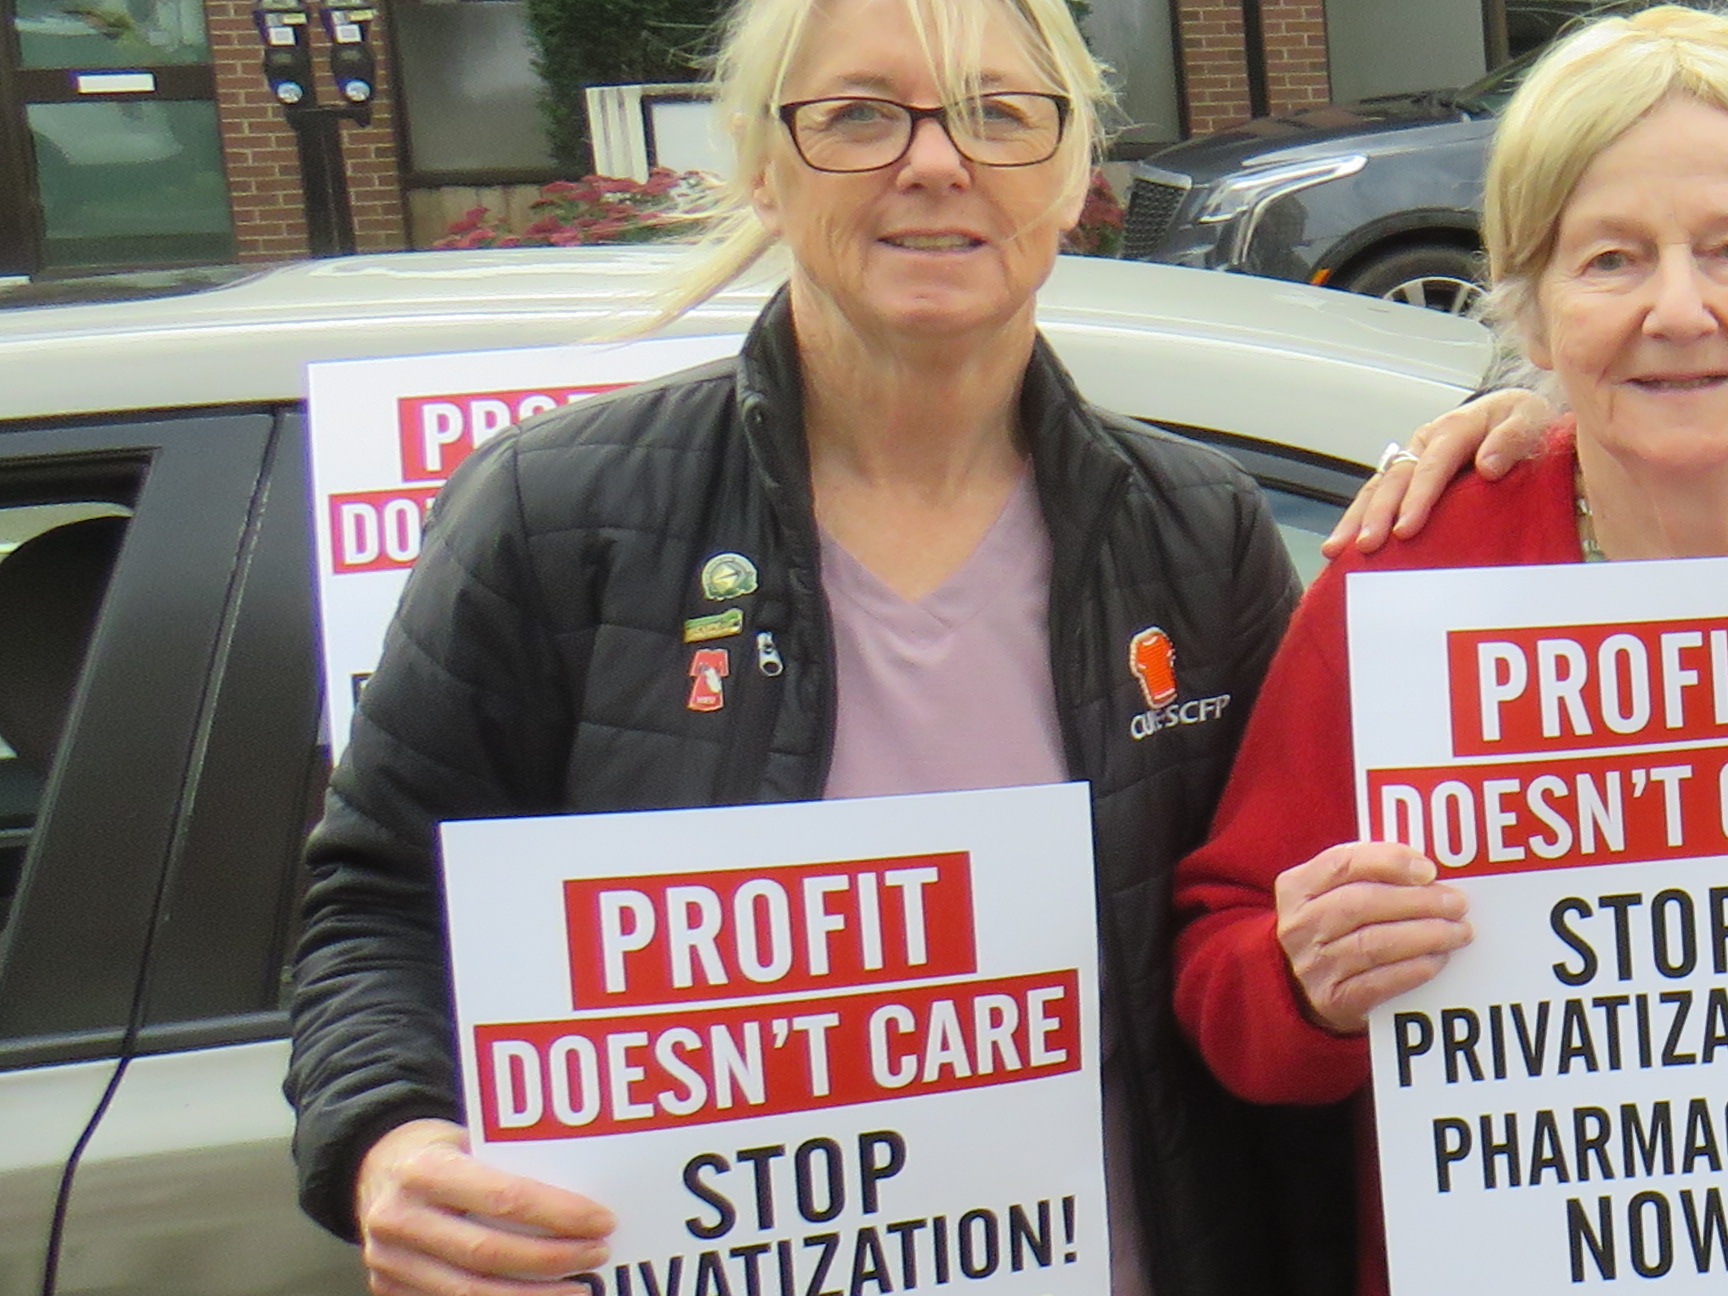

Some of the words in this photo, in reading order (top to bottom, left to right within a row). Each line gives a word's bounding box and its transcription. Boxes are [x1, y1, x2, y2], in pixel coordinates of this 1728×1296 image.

[1380, 764, 1694, 869] DOESN'T
[599, 865, 939, 995] PROFIT
[495, 1012, 840, 1129] DOESN'T
[869, 986, 1068, 1090] CARE
[684, 1130, 908, 1240] STOP
